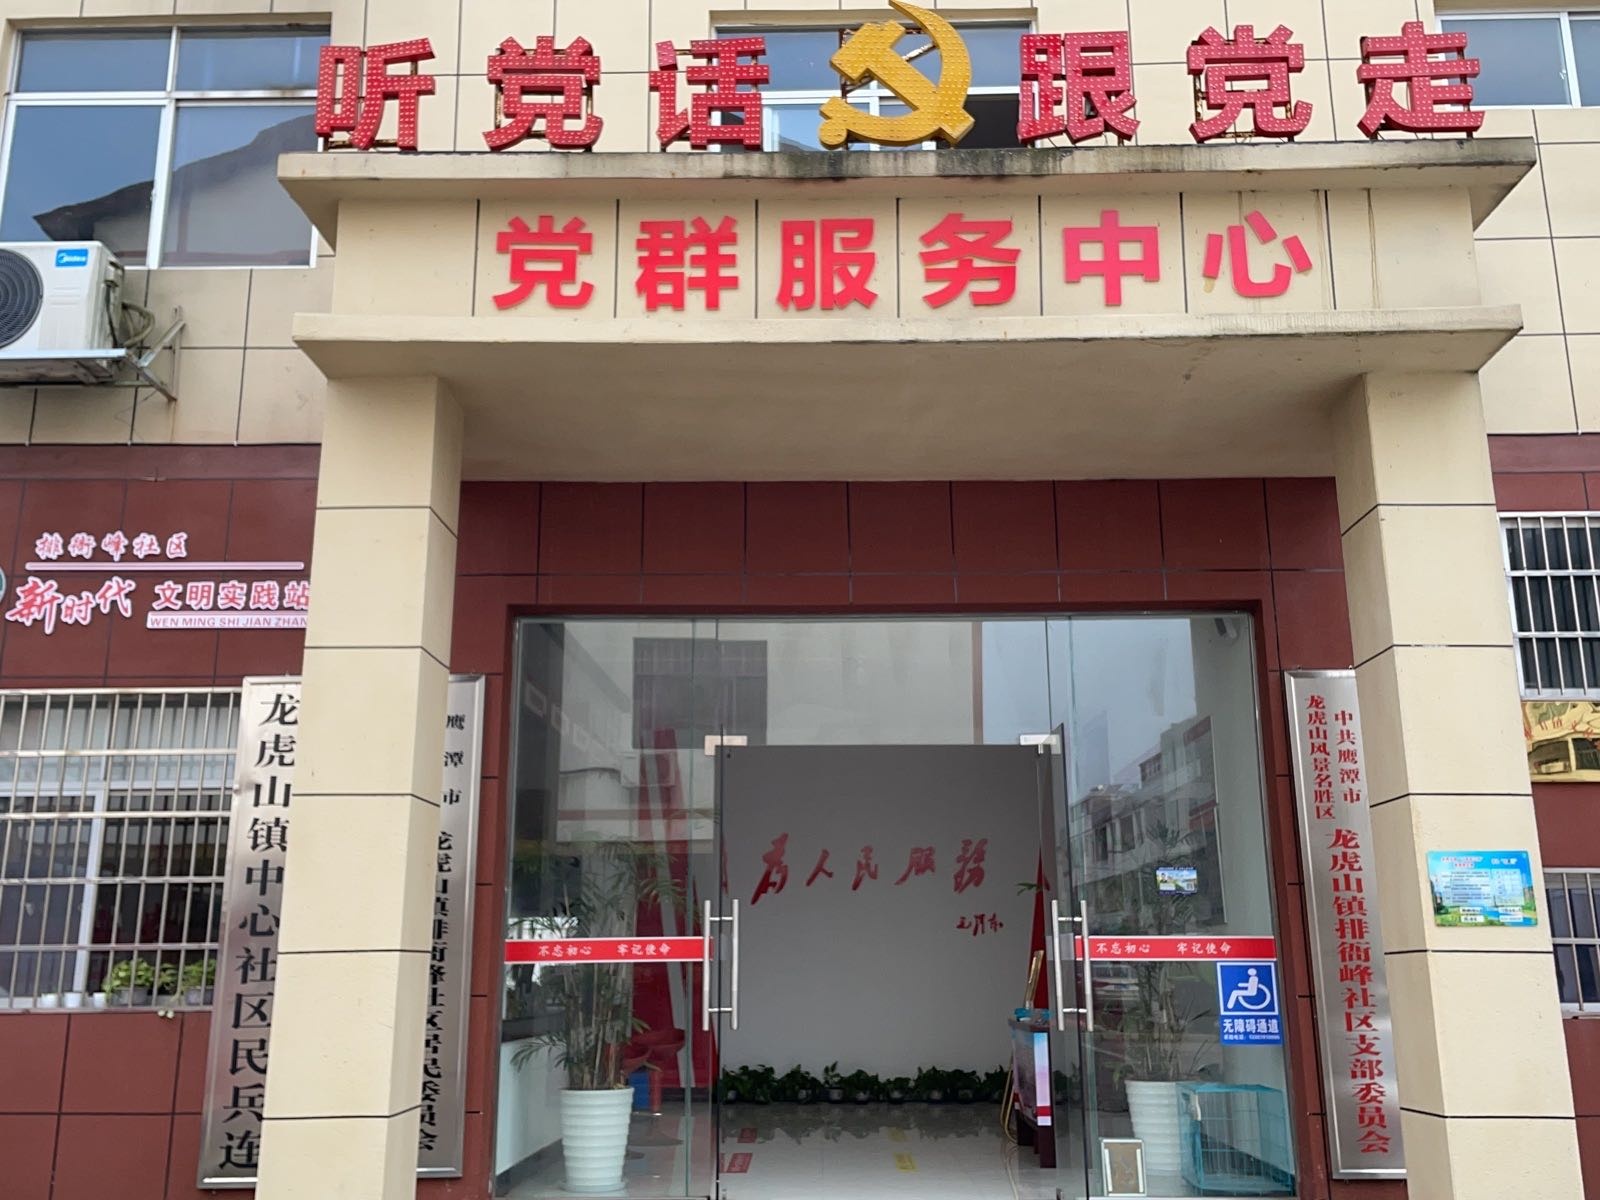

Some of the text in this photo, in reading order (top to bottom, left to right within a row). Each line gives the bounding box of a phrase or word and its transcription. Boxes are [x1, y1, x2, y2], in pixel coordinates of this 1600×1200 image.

[314, 21, 1486, 152] 听党话 跟党走
[491, 209, 1313, 313] 党群服务中心
[5, 576, 310, 635] 新时代 文明实践站
[150, 617, 179, 628] WEN
[182, 617, 216, 628] MING
[219, 617, 241, 628] SHI
[243, 617, 272, 628] JIAN
[443, 713, 466, 806] 鹰潭市
[1305, 694, 1337, 820] 龙虎山风景名胜区
[1334, 709, 1362, 805] 中共鹰潭市
[217, 692, 300, 1170] 龙虎山镇中心社区民兵连
[537, 942, 672, 958] 不忘初心 牢记使命
[1096, 941, 1232, 955] 不忘初心 牢记使命
[1223, 1018, 1280, 1034] 无障碍通道
